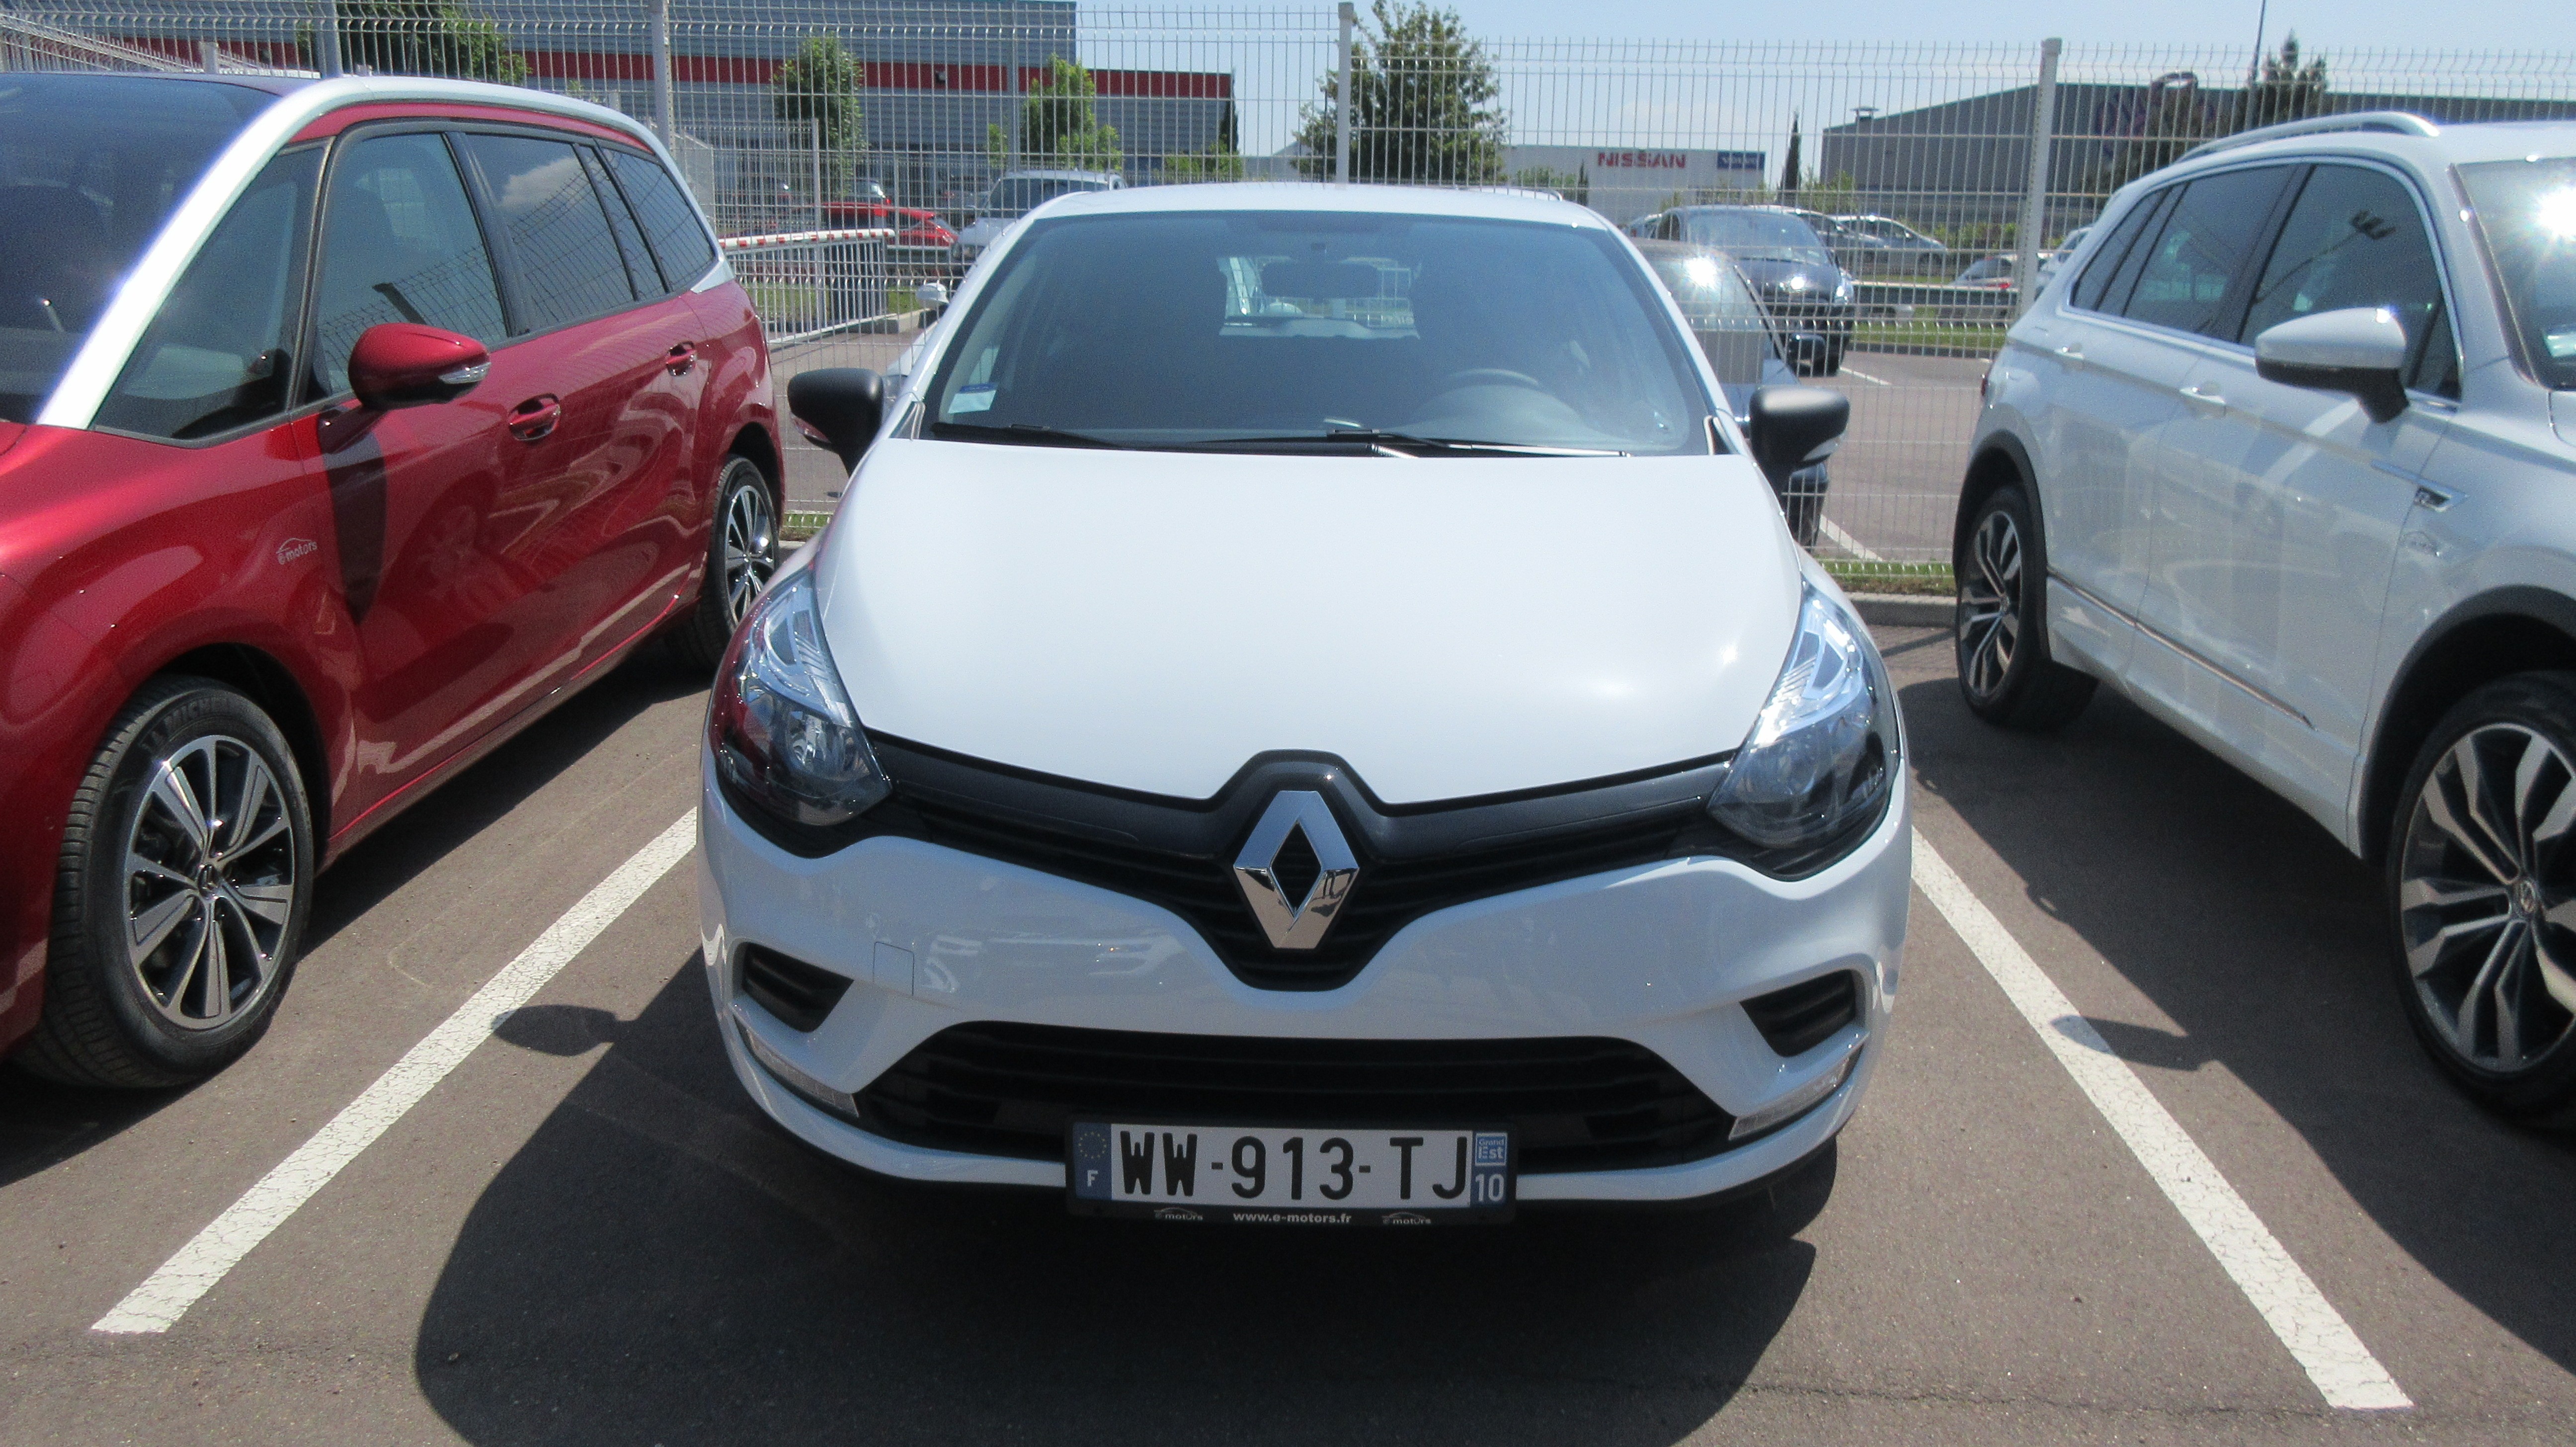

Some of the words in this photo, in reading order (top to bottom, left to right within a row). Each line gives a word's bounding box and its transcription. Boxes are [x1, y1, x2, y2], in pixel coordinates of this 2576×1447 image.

[1597, 152, 1687, 169] NISSAN
[1478, 1146, 1504, 1159] Est
[1120, 1130, 1467, 1200] WW-913-TJ
[1087, 1170, 1099, 1187] F
[1475, 1173, 1505, 1202] 10
[1233, 1212, 1352, 1224] www.e-motors.fr
